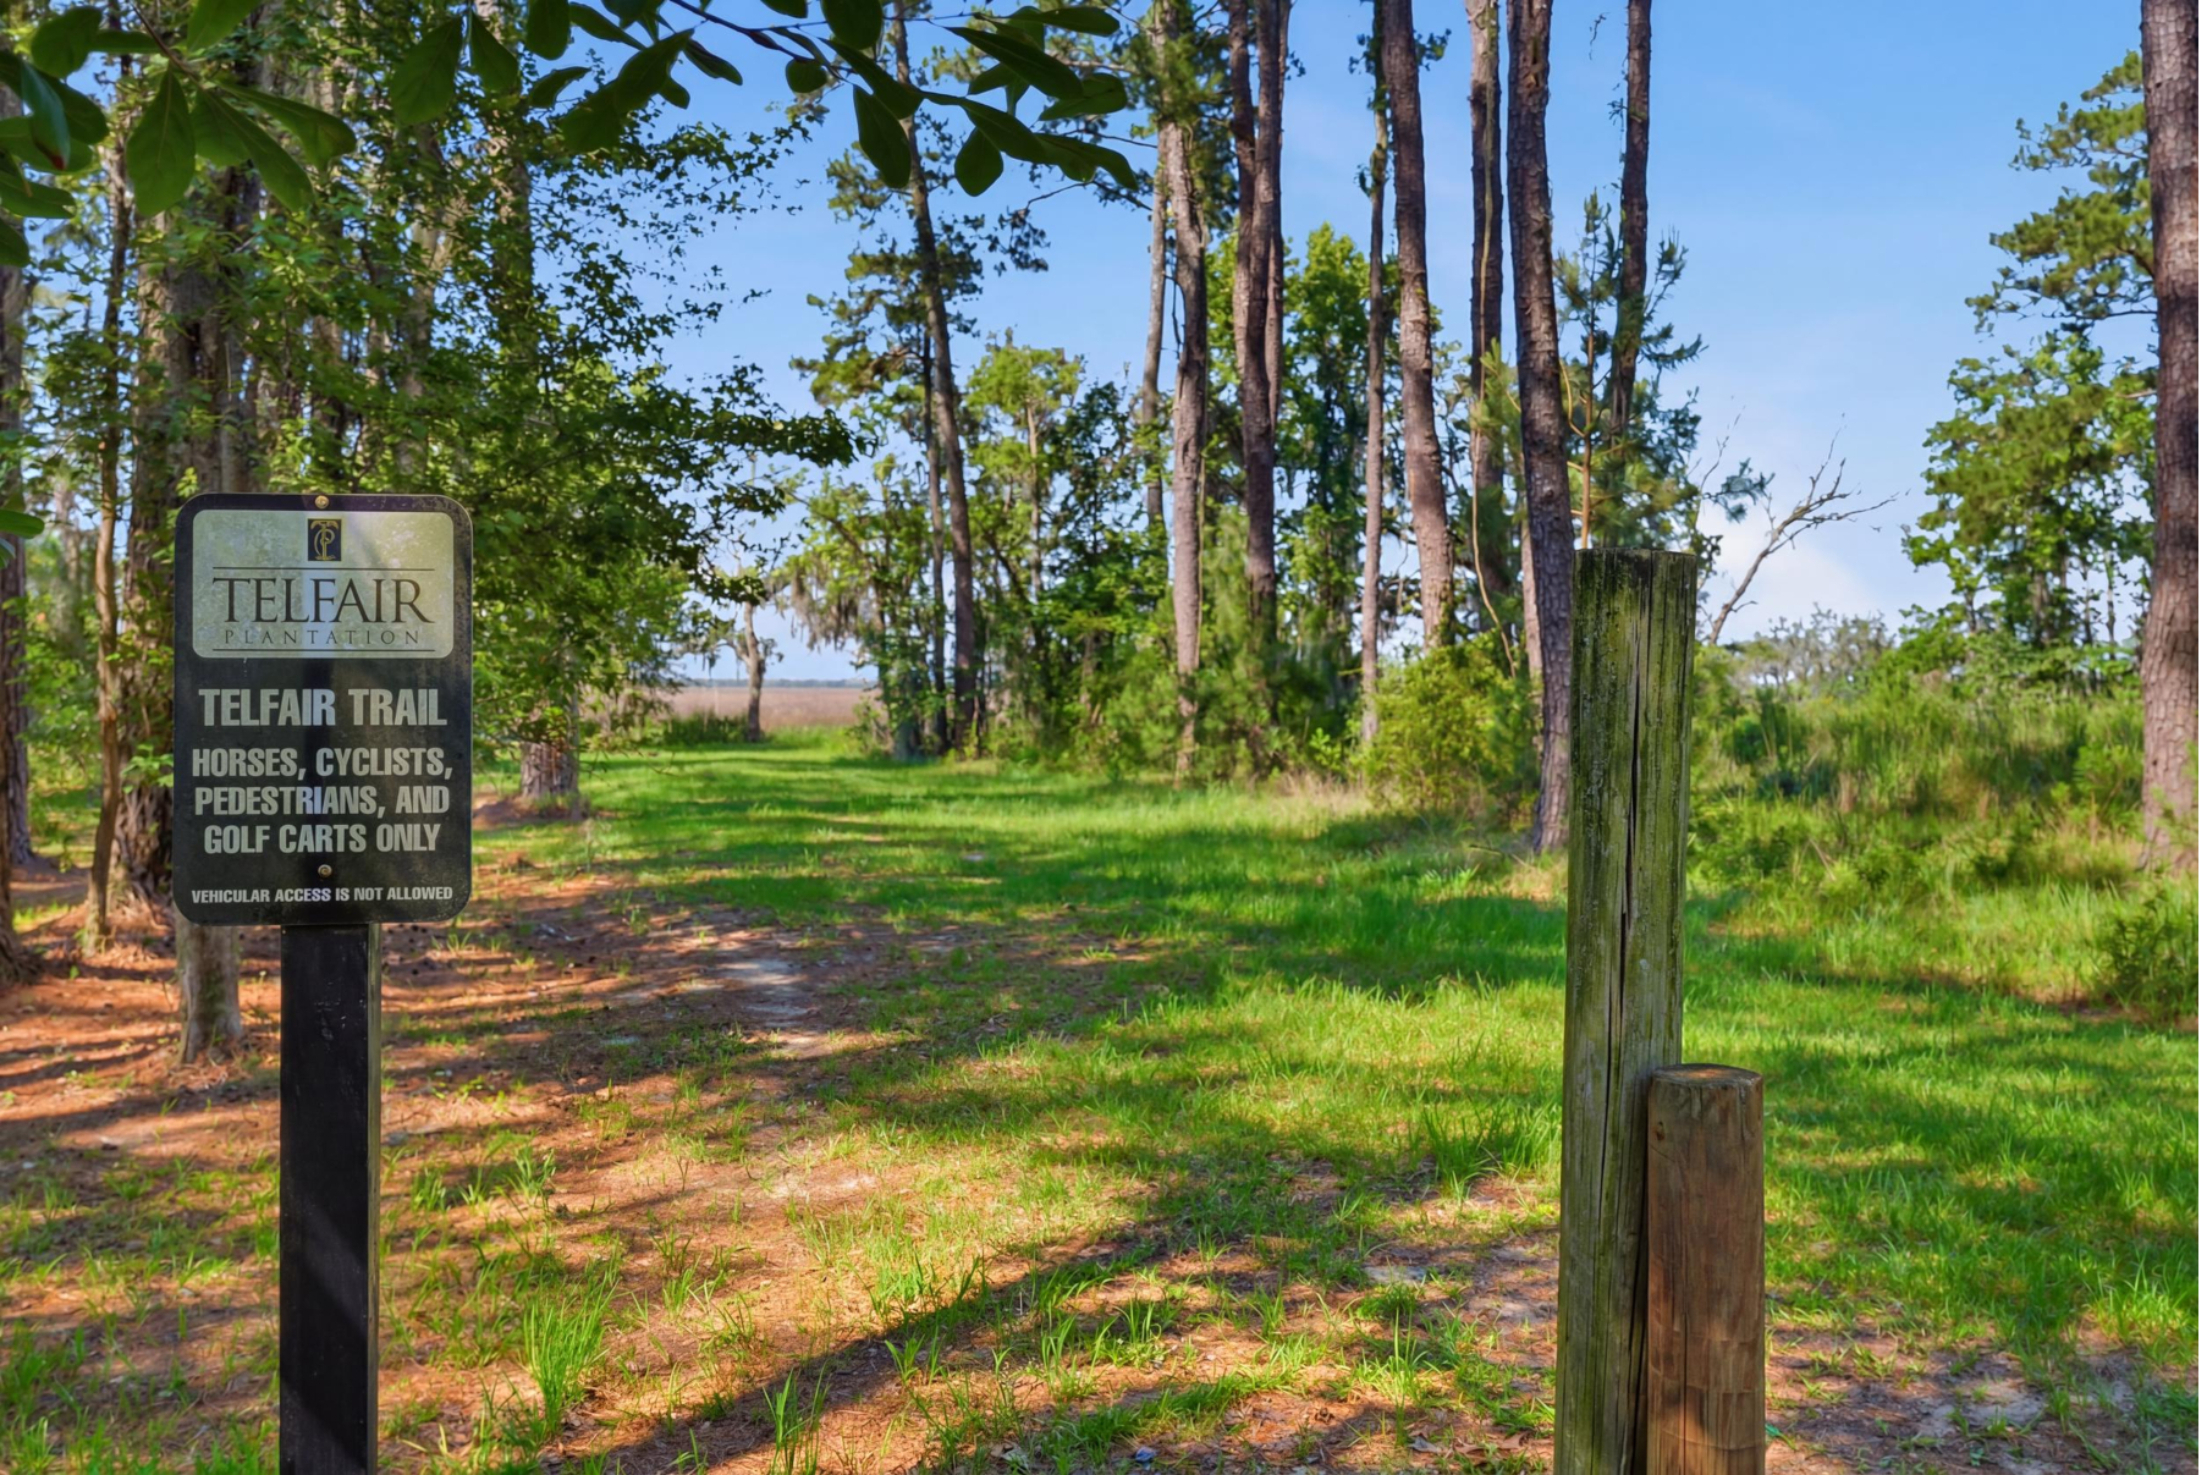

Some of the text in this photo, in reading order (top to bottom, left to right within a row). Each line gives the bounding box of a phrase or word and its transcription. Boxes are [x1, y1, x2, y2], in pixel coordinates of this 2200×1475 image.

[212, 577, 435, 624] TELFAIR
[224, 630, 420, 645] PLANTATION
[198, 688, 448, 726] TELFAIR TRAIL
[192, 747, 453, 781] HORSES, CYCLISTS,
[195, 785, 450, 819] PEDESTRIANS, AND
[204, 823, 441, 854] GOLF CARTS ONLY
[192, 886, 453, 903] VEHICULAR ACCESS IS NOT ALLOWED
